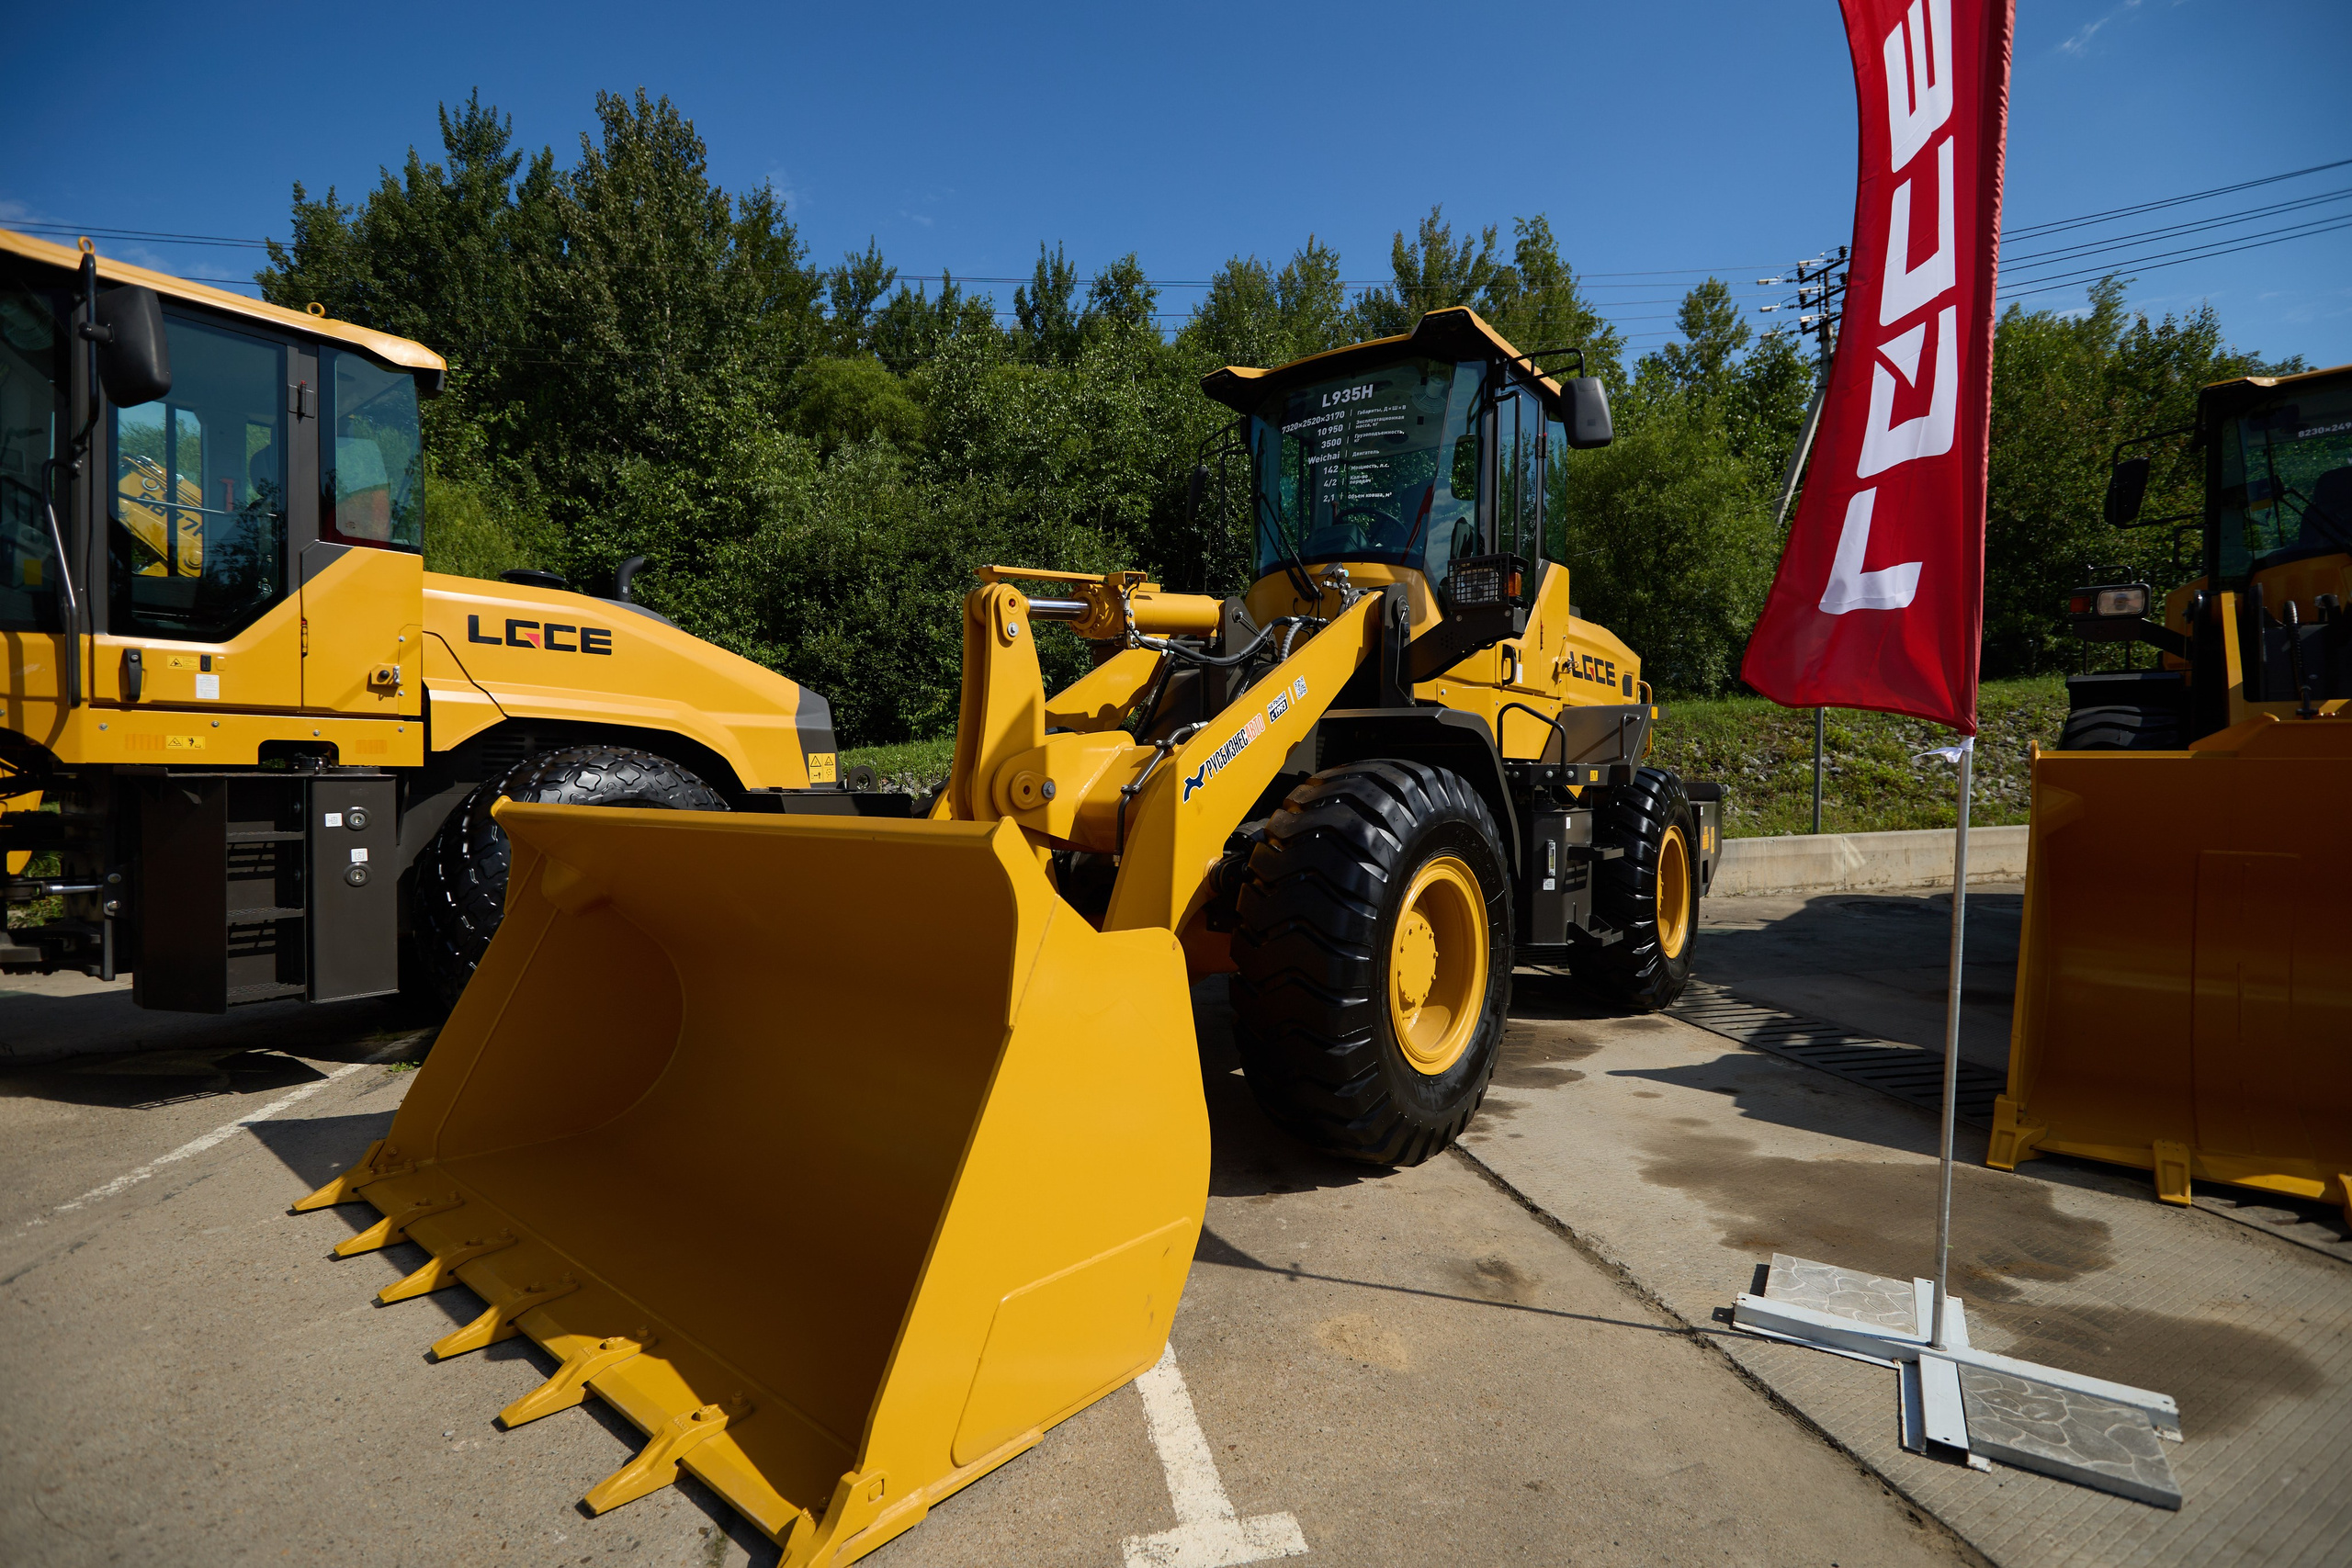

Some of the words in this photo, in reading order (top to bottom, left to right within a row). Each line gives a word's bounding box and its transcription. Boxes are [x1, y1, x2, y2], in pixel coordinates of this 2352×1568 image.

[1321, 384, 1374, 408] L935H
[1321, 437, 1341, 449] 3500
[1307, 451, 1340, 465] Weichai
[1351, 449, 1380, 457] Двигатель
[1323, 465, 1339, 475] 142
[1324, 479, 1338, 488] 4/2
[1323, 494, 1335, 502] 2,1
[468, 615, 612, 656] LGCE
[1569, 650, 1616, 687] LGCE
